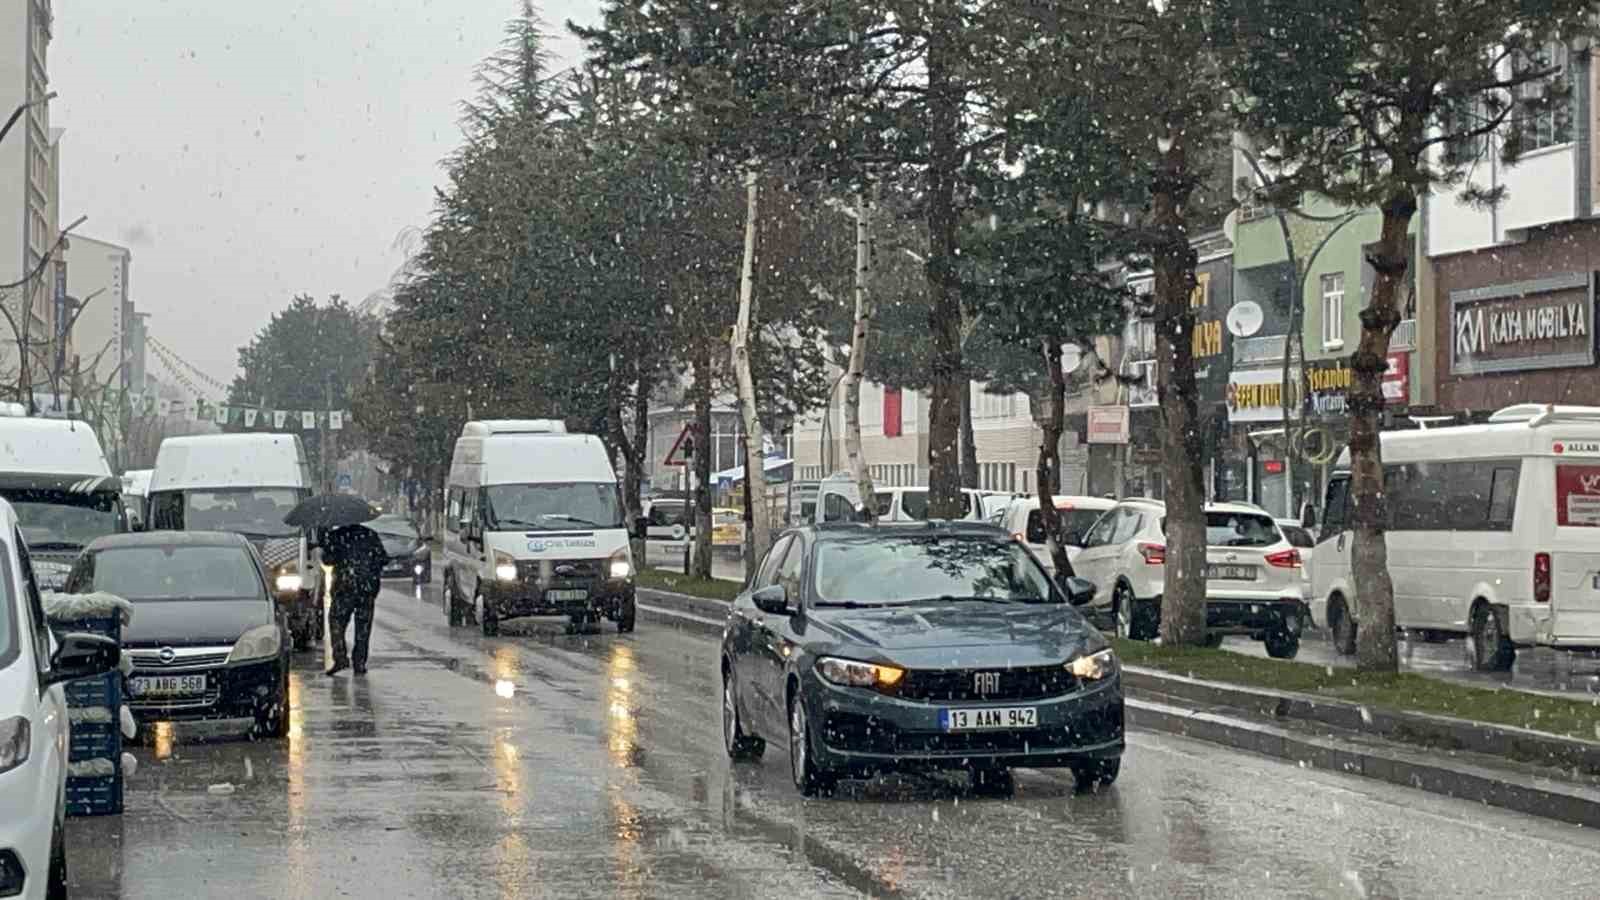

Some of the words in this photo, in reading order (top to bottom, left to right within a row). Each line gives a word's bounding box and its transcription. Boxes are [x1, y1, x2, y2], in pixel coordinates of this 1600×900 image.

[1490, 310, 1523, 344] KAYA
[973, 672, 1001, 694] FIAT
[952, 712, 967, 727] 13
[976, 711, 1001, 726] AAN
[1008, 709, 1034, 725] 942
